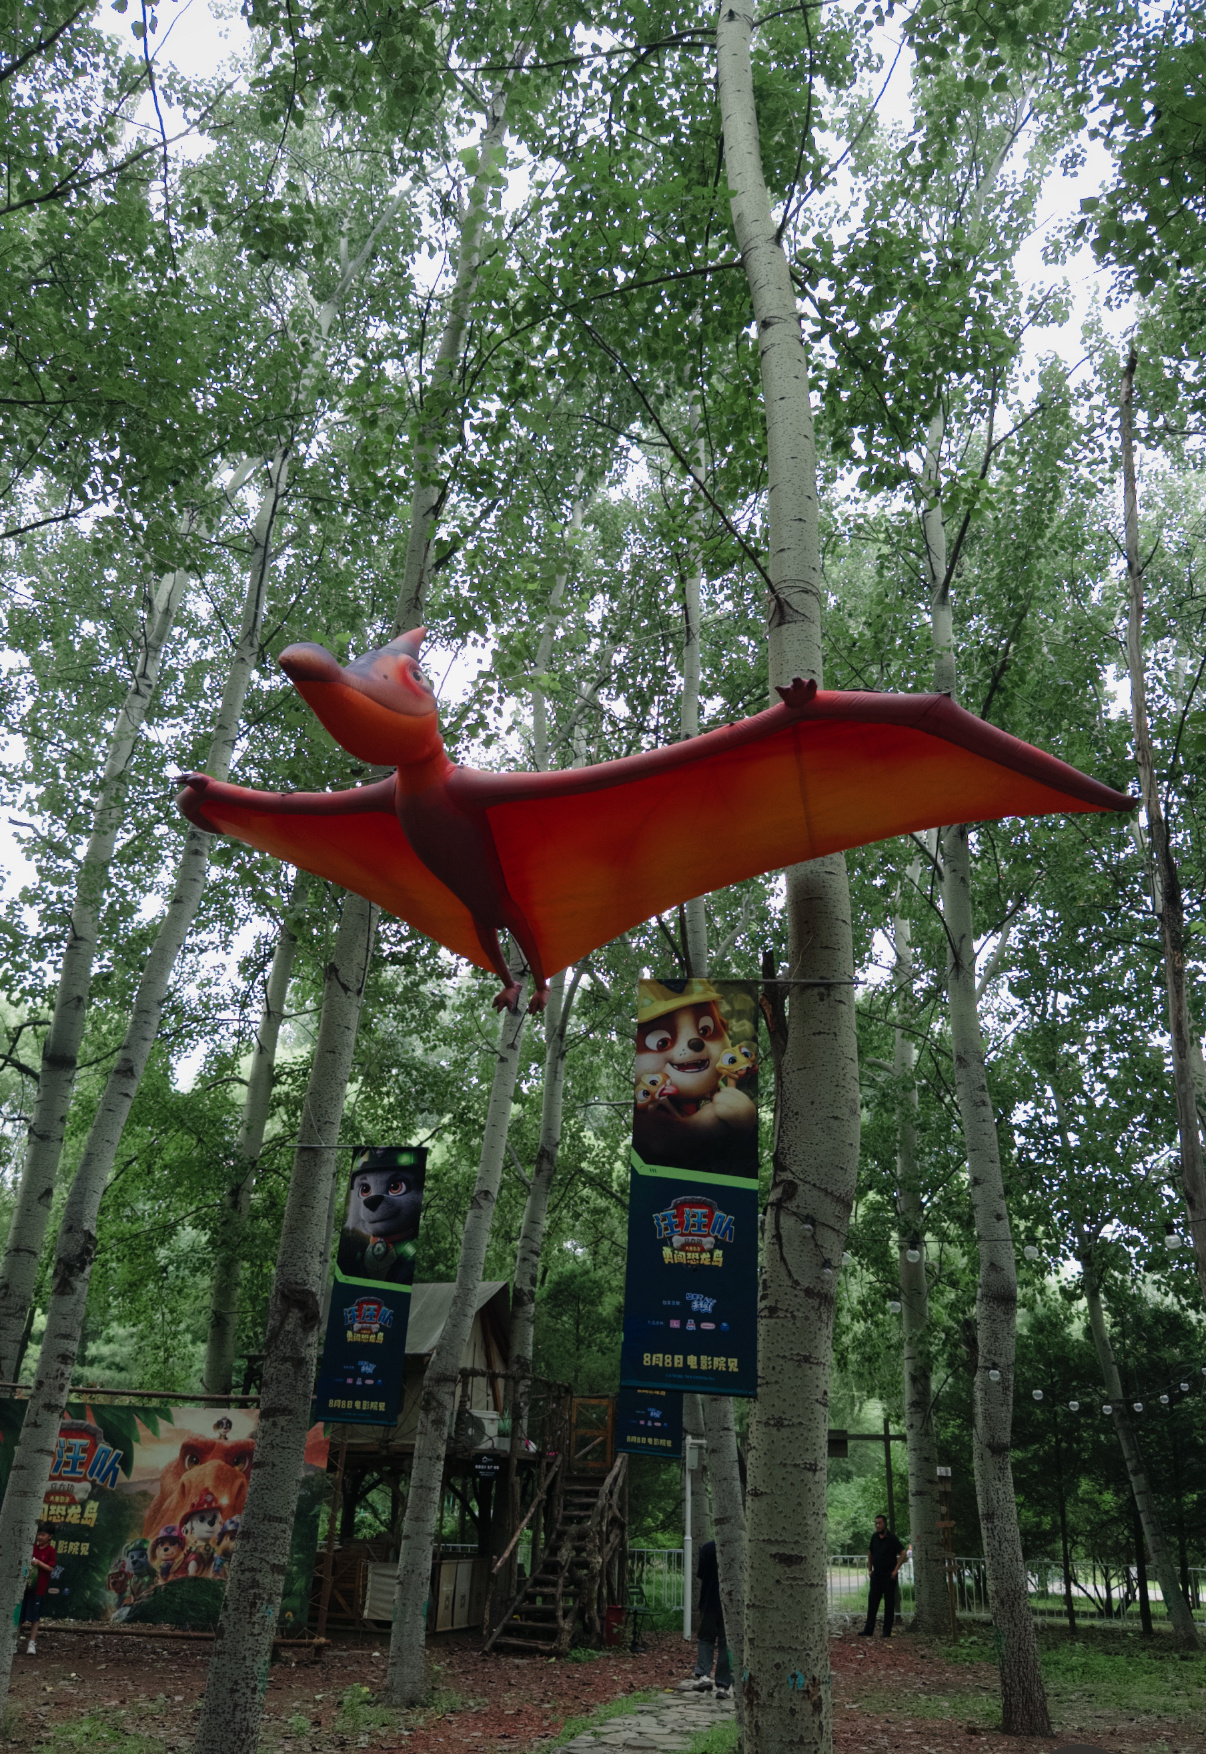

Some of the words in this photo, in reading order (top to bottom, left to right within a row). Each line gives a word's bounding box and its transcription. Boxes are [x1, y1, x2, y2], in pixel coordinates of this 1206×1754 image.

[652, 1207, 735, 1243] 汪汪队
[662, 1246, 724, 1267] 勇闯恐龙岛
[343, 1304, 394, 1328] 汪汪队
[643, 1353, 684, 1368] 8月8日
[686, 1354, 739, 1372] 电影院见
[328, 1398, 353, 1409] 8月8日
